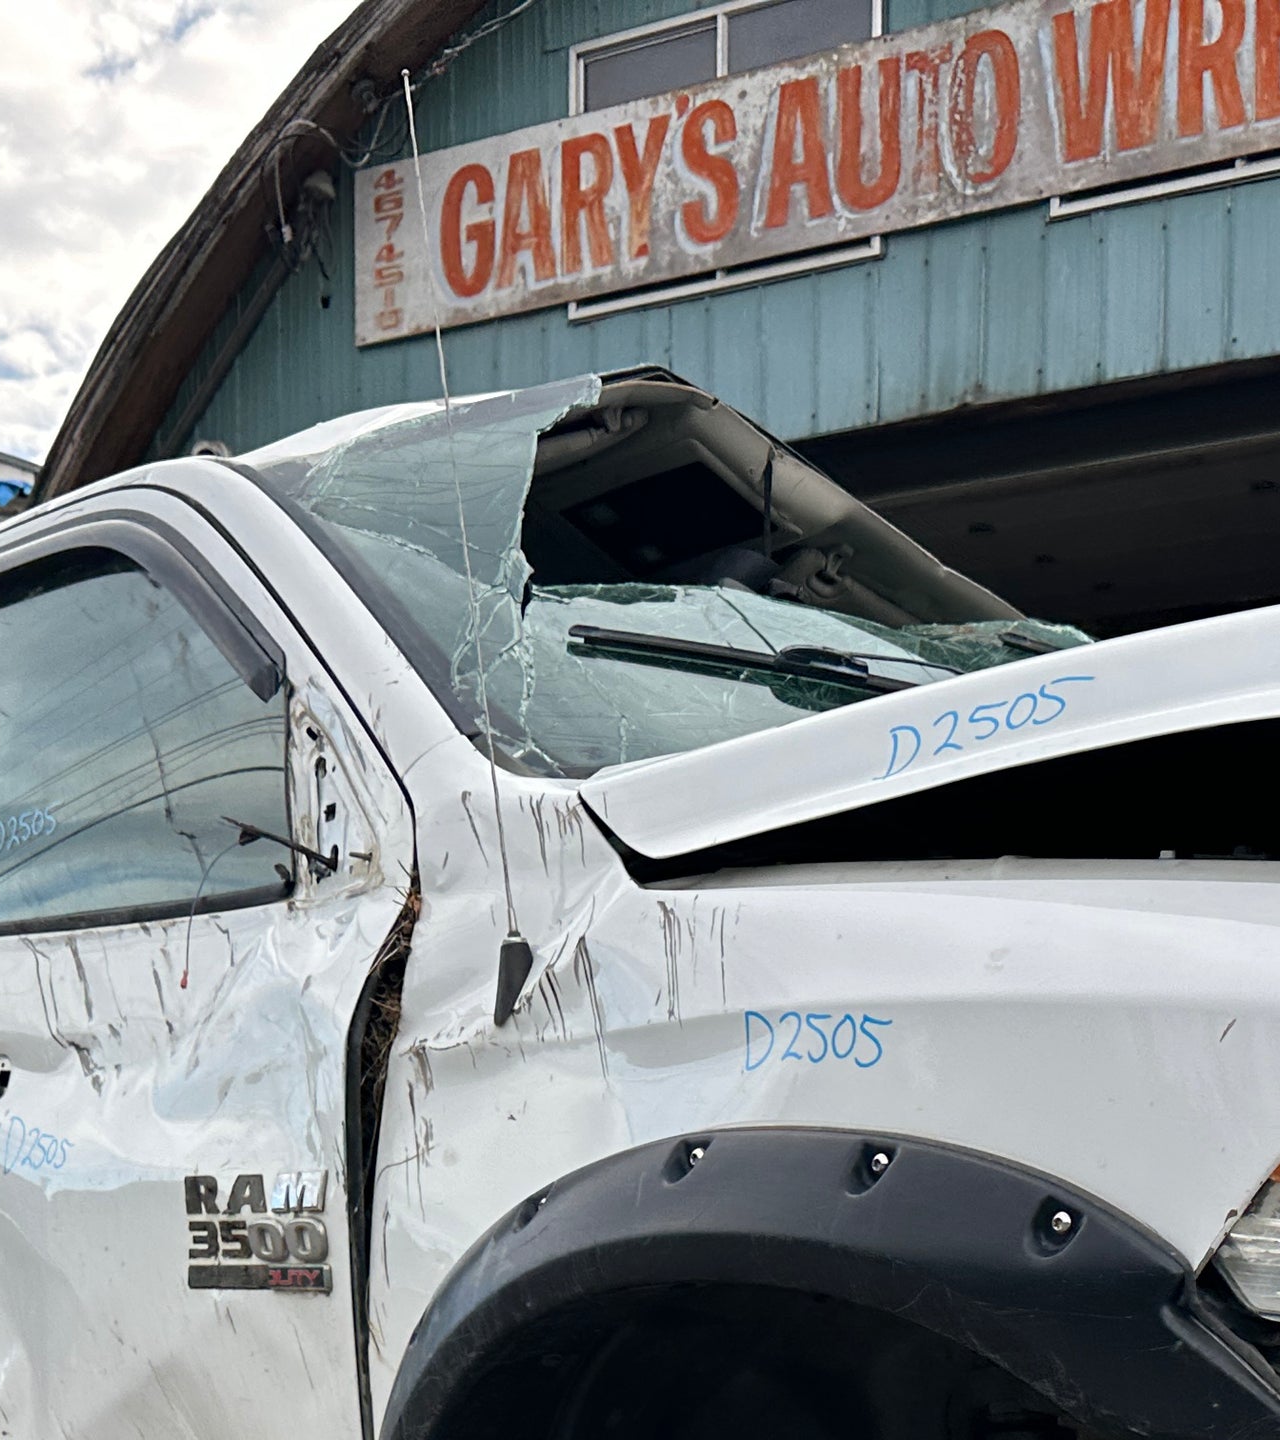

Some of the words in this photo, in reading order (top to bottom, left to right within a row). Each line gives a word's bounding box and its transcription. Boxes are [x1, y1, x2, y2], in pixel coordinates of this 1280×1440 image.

[440, 94, 740, 298] GARY'S
[760, 28, 1020, 229] AUTO
[874, 675, 1096, 781] D2505
[743, 1010, 893, 1072] D2505
[3, 1115, 75, 1176] D2505
[184, 1169, 328, 1215] RAM
[188, 1215, 329, 1264] 3500
